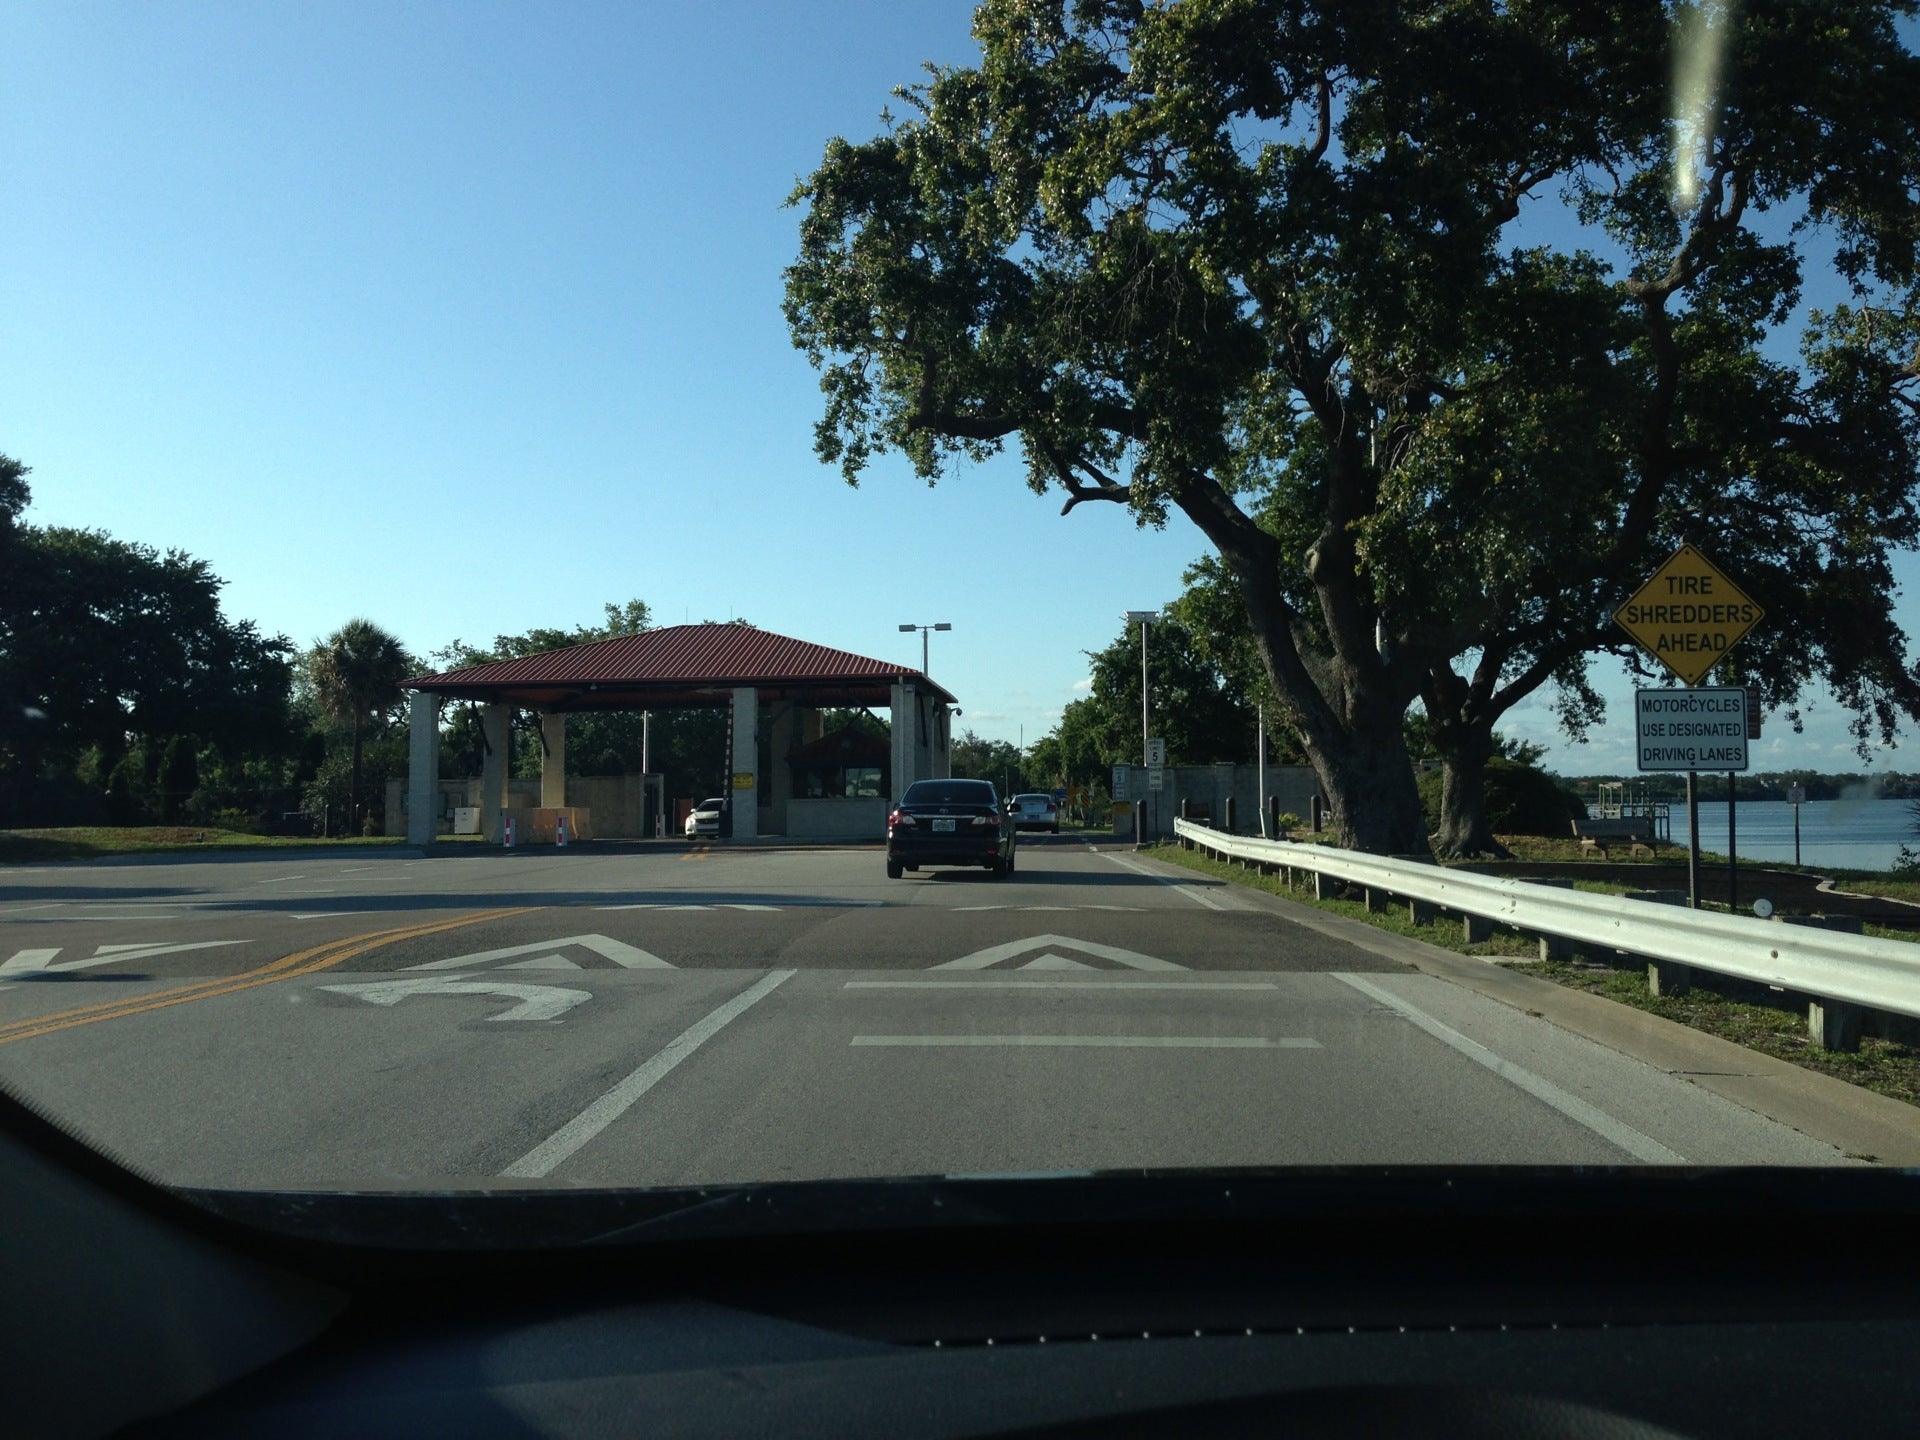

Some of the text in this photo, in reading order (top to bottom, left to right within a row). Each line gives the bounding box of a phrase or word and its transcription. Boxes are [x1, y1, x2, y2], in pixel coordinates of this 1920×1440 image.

[1665, 575, 1713, 595] TIRE
[1627, 604, 1754, 624] SHREDDERS
[1657, 633, 1727, 652] AHEAD
[1642, 699, 1740, 712] MOTORCYCLES
[1643, 723, 1741, 737] USE DESIGNATED
[1152, 751, 1159, 762] 5
[1643, 747, 1742, 761] DRIVING LANES
